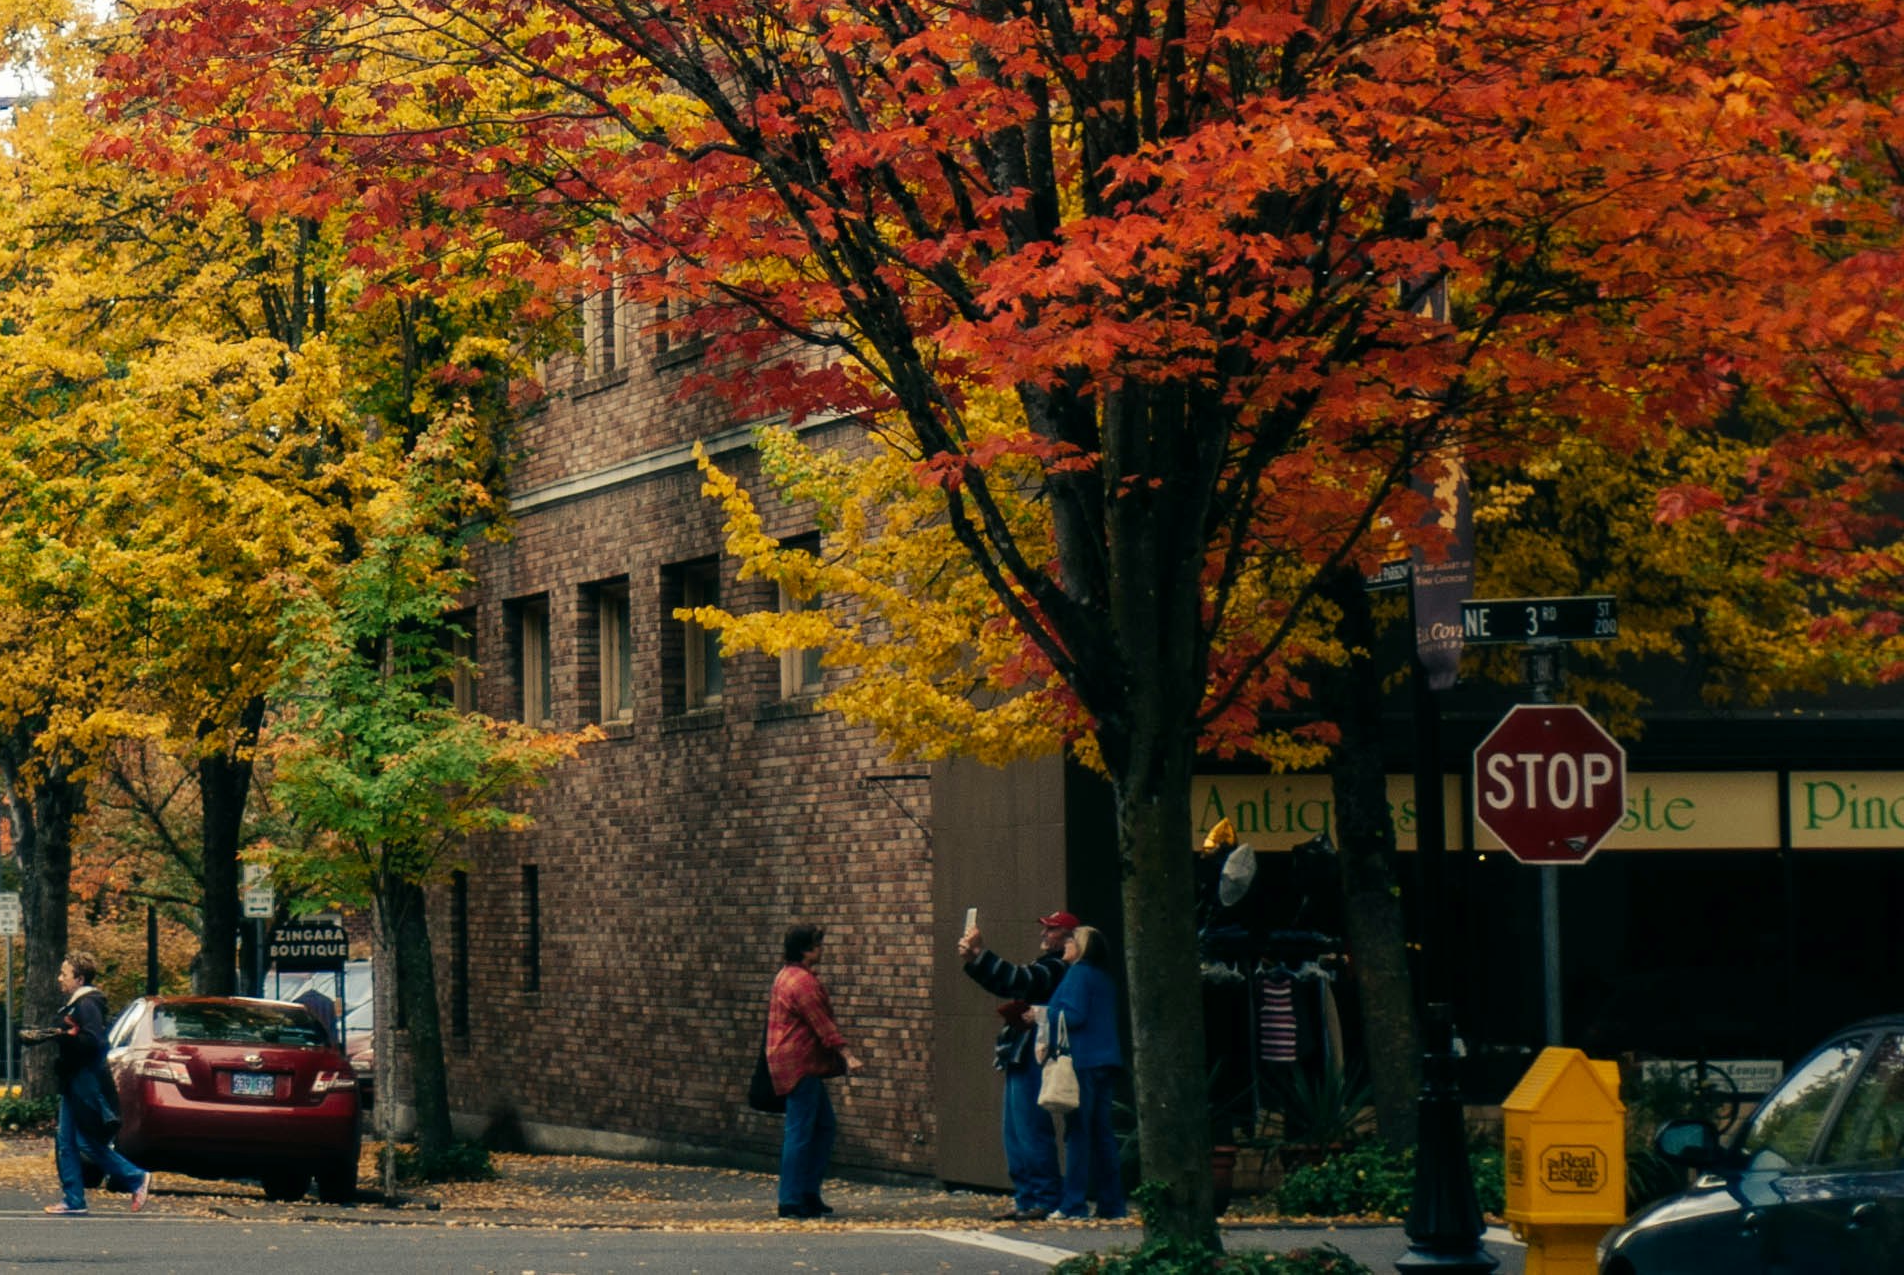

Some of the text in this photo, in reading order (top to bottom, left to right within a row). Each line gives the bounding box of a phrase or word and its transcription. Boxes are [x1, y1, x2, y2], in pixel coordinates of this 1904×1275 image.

[1597, 601, 1610, 617] ST
[1464, 608, 1491, 637] NE
[1594, 618, 1617, 634] 200
[1485, 753, 1614, 810] STOP
[1198, 783, 1417, 837] Antiqs
[274, 928, 345, 942] ZINGARA
[269, 943, 348, 957] BOUTIQUE
[1559, 1150, 1597, 1168] Real
[1547, 1165, 1599, 1183] Estate
